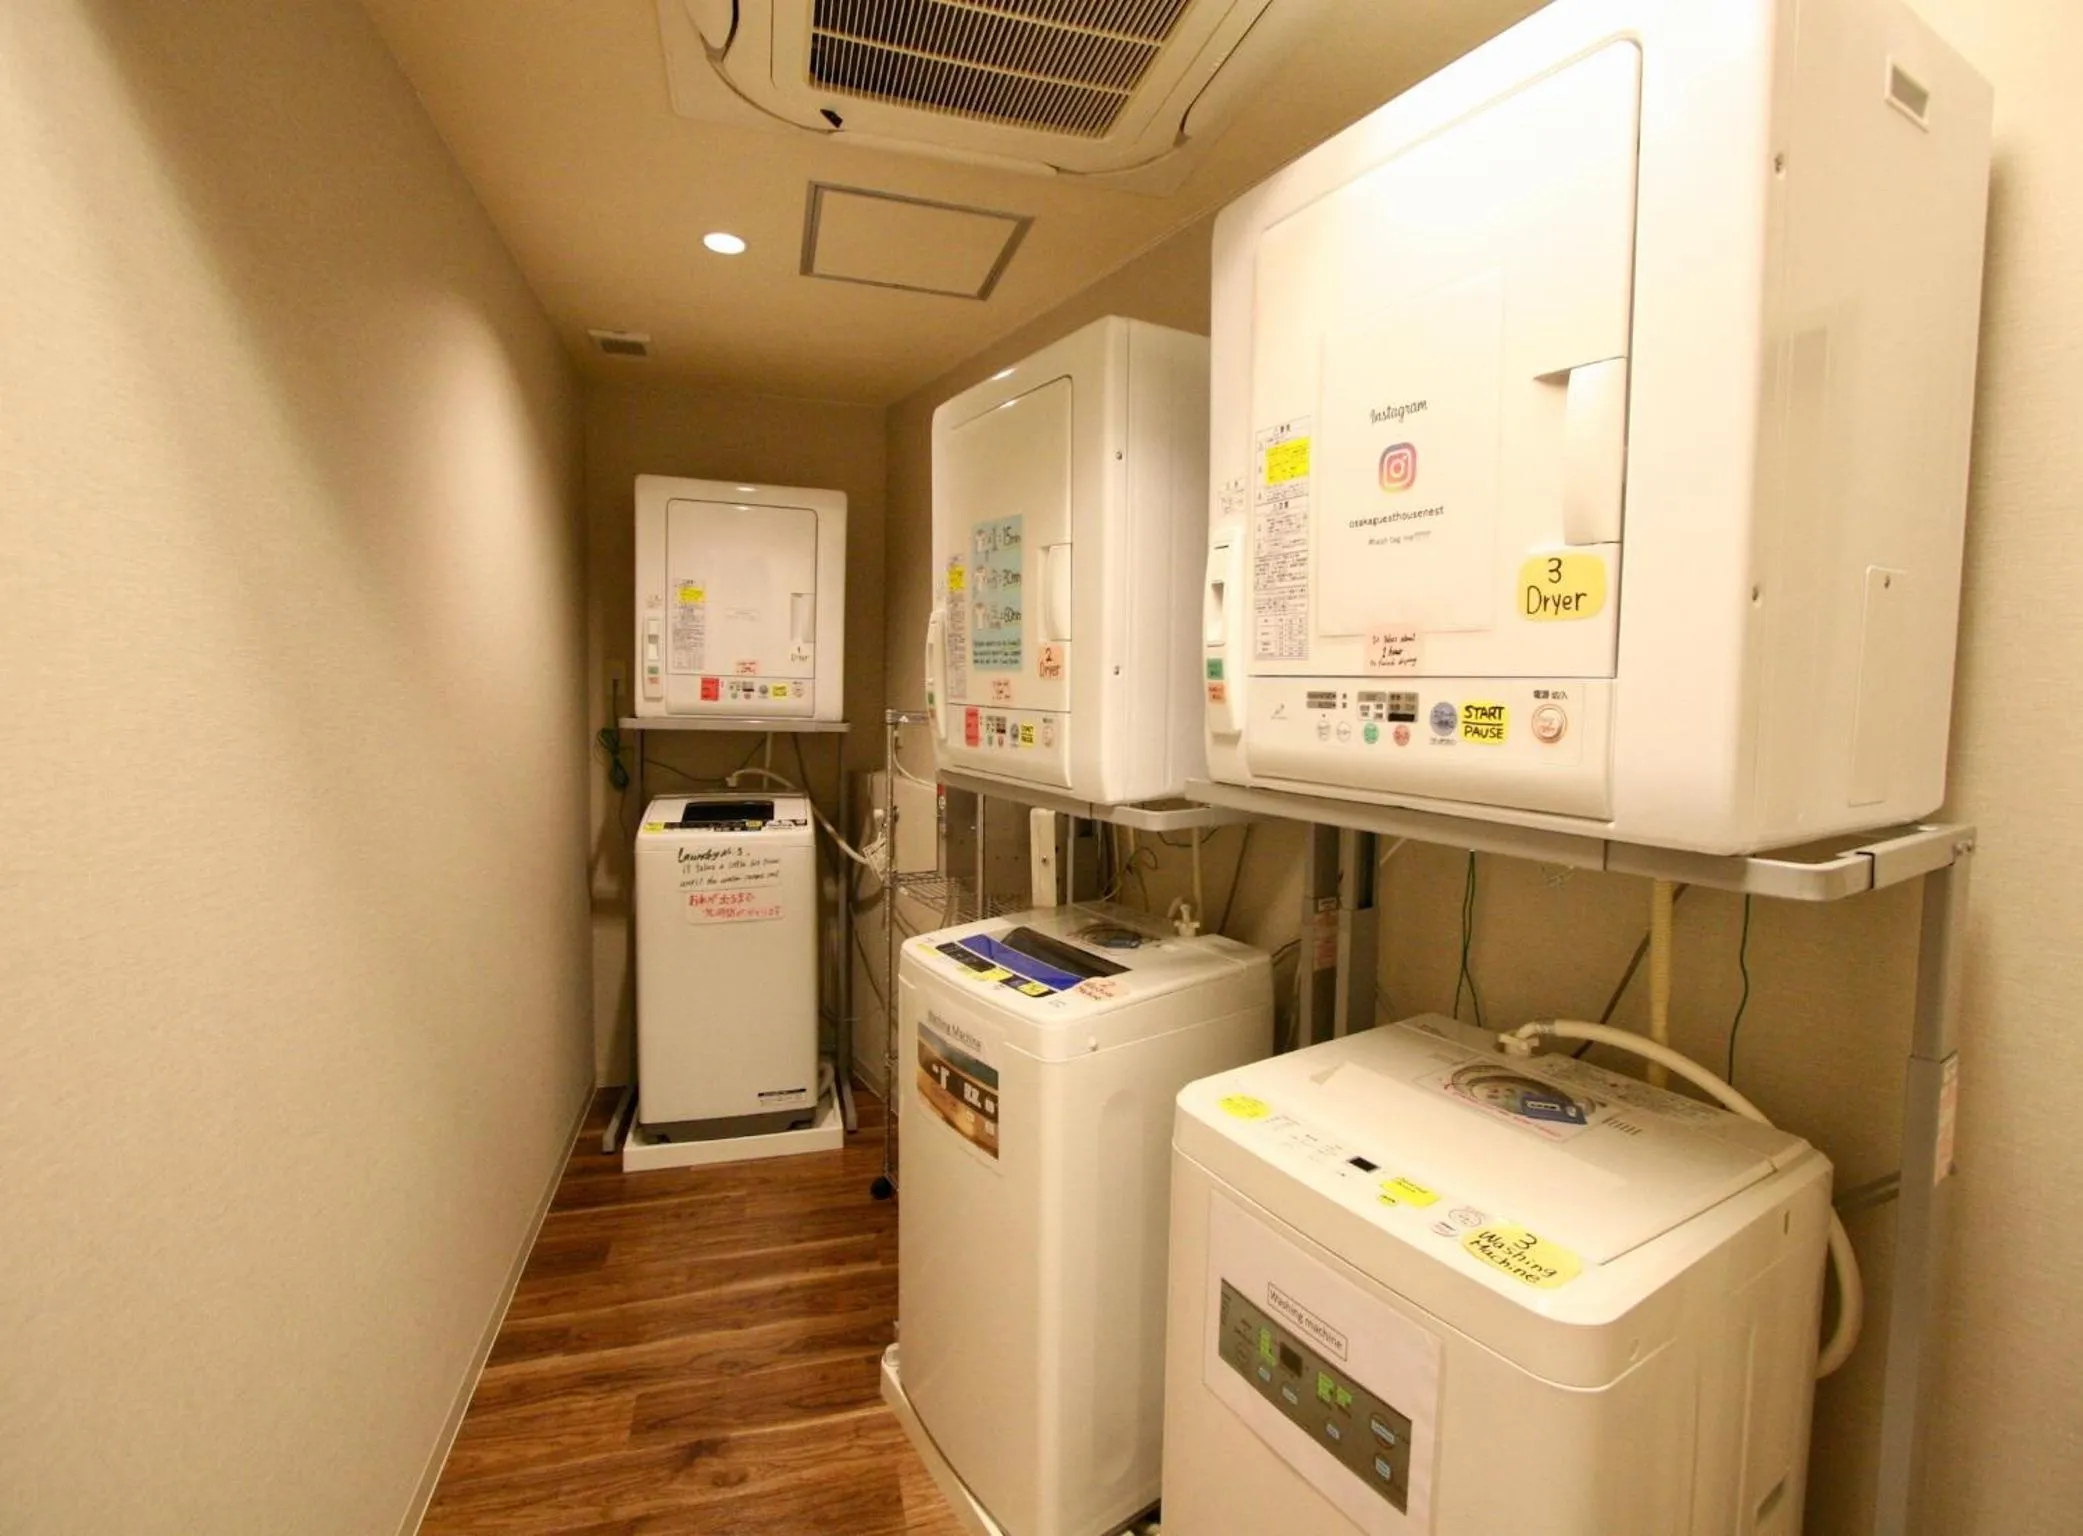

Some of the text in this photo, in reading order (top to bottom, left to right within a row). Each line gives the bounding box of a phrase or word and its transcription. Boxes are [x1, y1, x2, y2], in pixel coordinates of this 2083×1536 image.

[1370, 399, 1428, 424] Instagram
[1349, 505, 1444, 529] osakaguesthousenest
[1547, 557, 1563, 584] 3
[1526, 585, 1588, 615] Dryer
[1044, 647, 1053, 662] 2
[1464, 705, 1505, 720] START
[1464, 725, 1504, 739] PAUSE
[1513, 1232, 1537, 1250] 3
[1469, 1239, 1542, 1284] Machine
[1477, 1231, 1558, 1278] Washing
[1270, 1288, 1343, 1349] Washing machine
